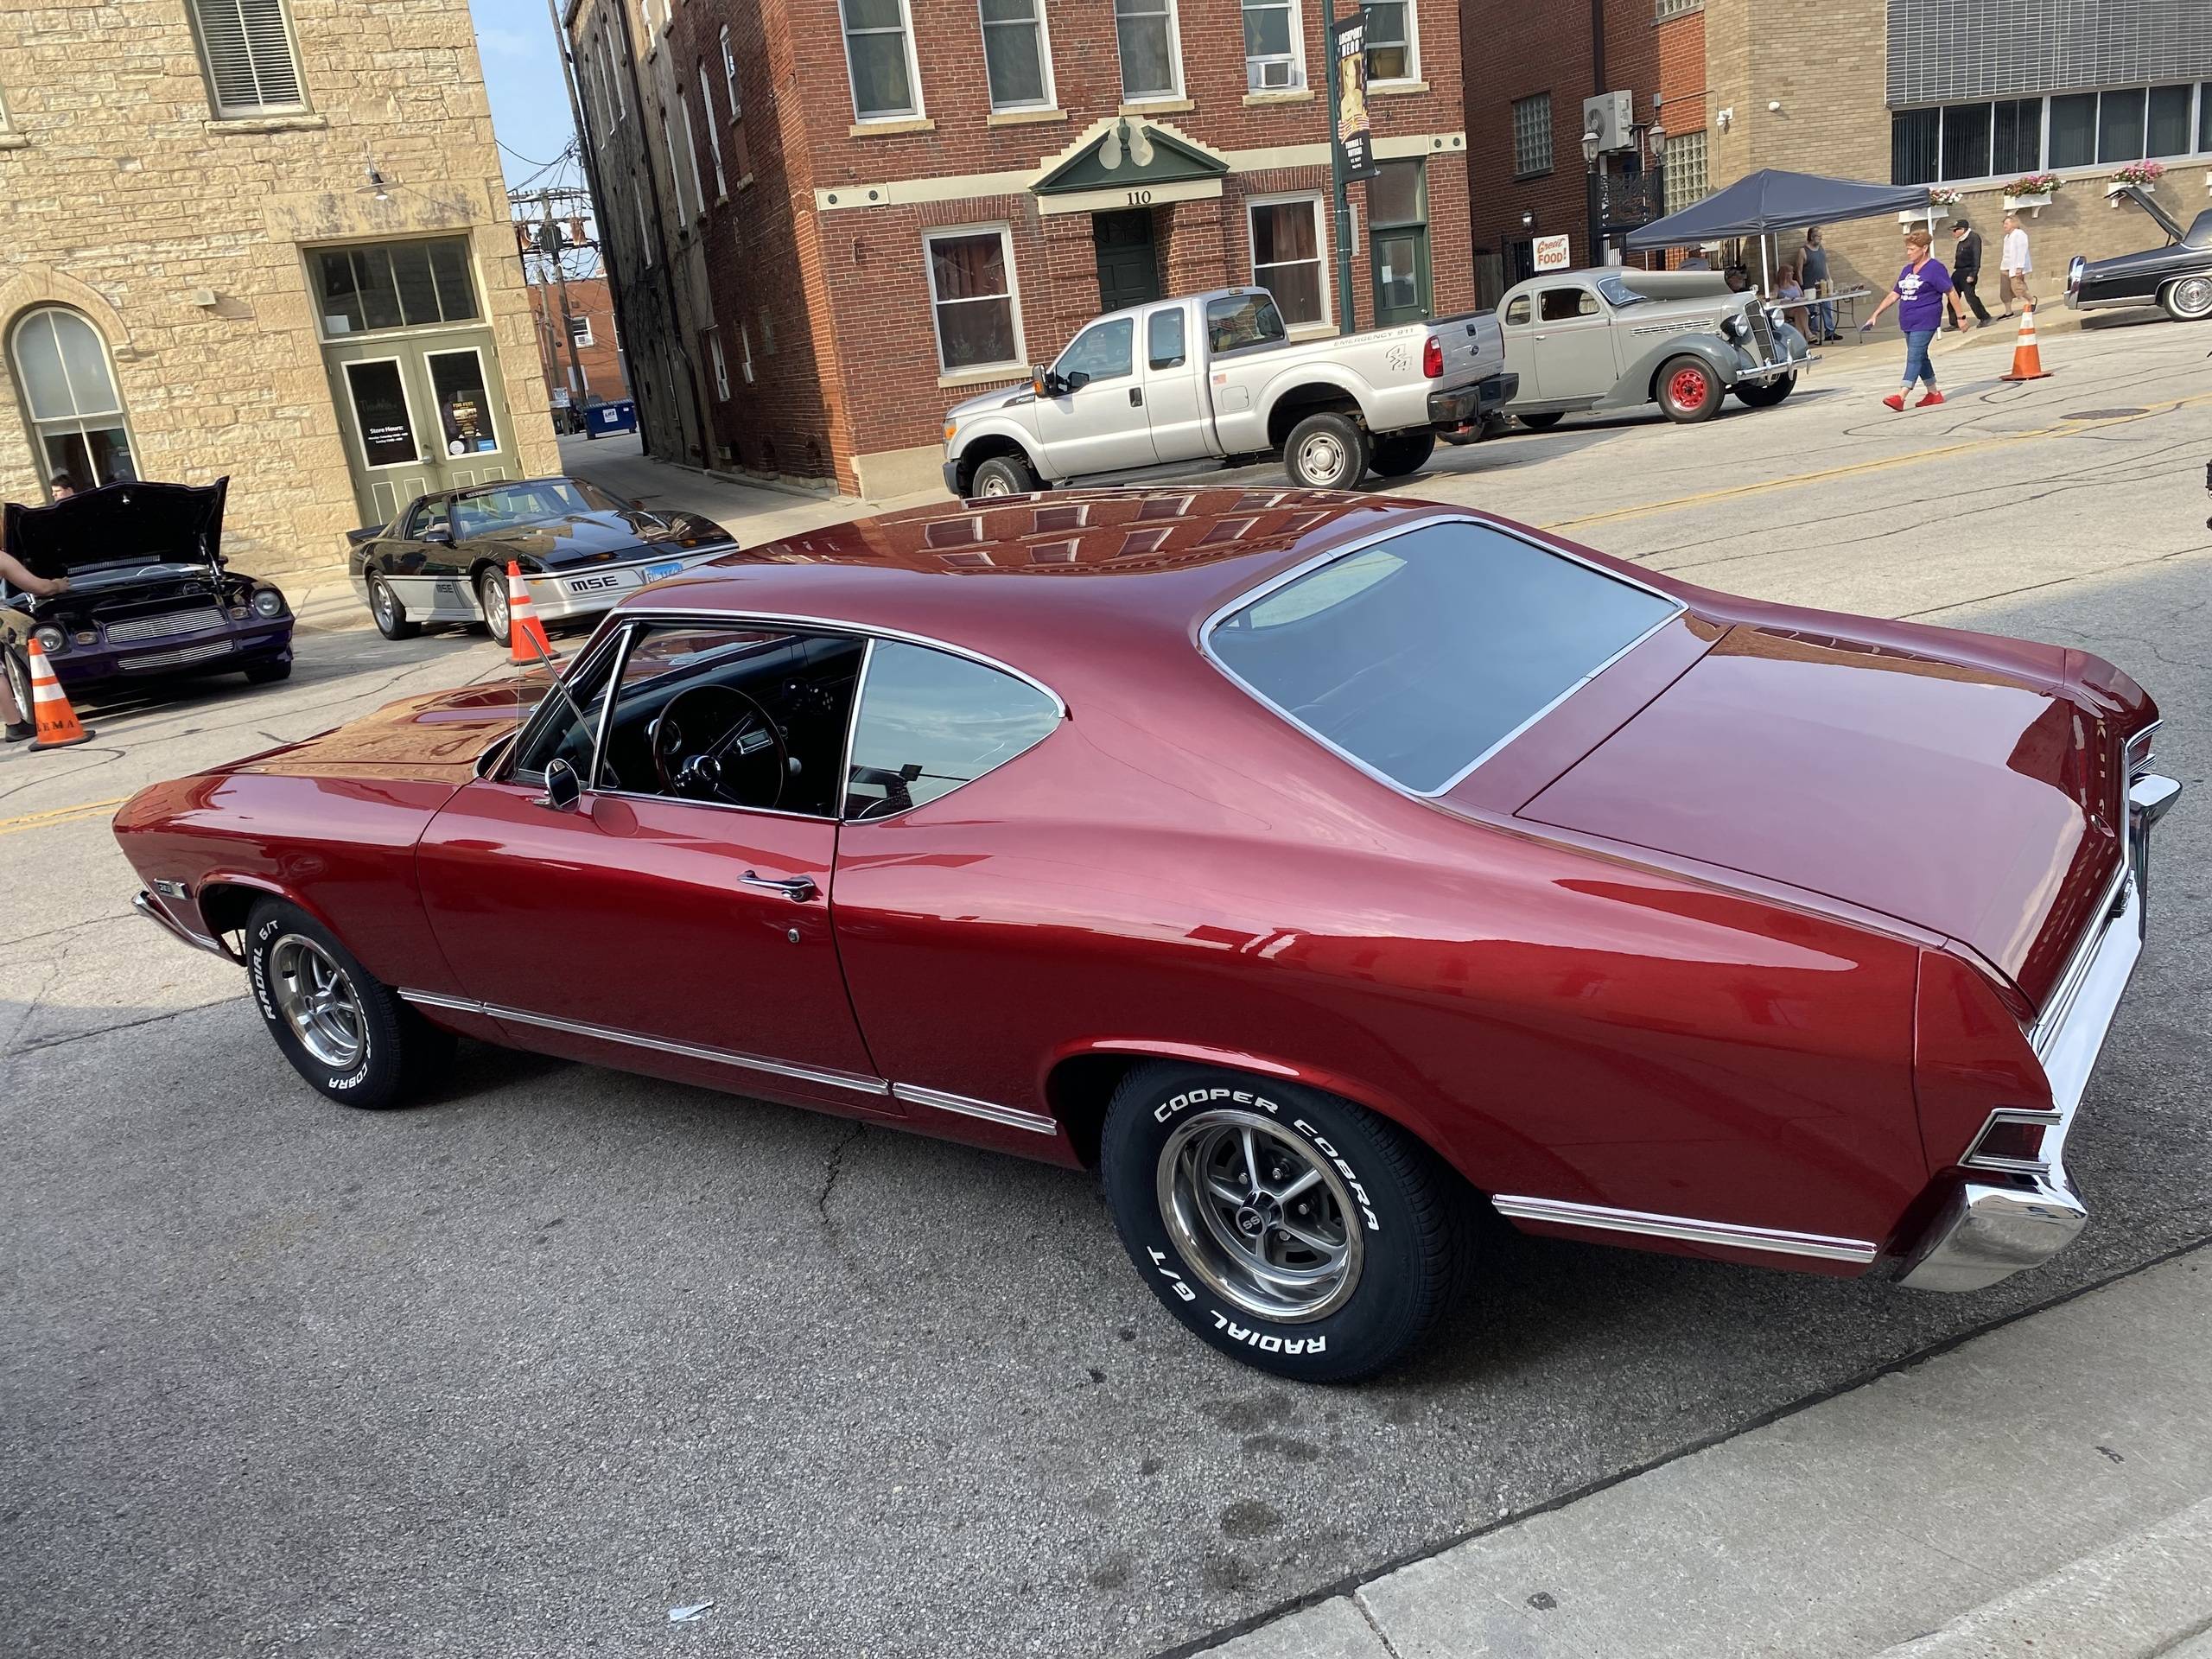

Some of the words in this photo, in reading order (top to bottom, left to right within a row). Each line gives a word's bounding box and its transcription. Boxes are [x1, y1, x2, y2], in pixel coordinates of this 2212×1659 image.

[1338, 25, 1363, 46] LOCKPORT
[1342, 39, 1360, 58] HERO
[1127, 190, 1152, 206] 110
[1537, 238, 1566, 254] Great
[1537, 247, 1567, 265] FOOD!
[1333, 332, 1393, 347] EMERGENCY
[1397, 327, 1414, 336] 911
[435, 584, 454, 594] MSE
[570, 575, 619, 592] MSE
[258, 919, 279, 941] G/T
[253, 947, 276, 1020] RADIAL
[327, 1061, 368, 1090] COBRA
[1154, 1088, 1279, 1123] COOPER
[1293, 1119, 1380, 1231] COBRA
[1242, 1215, 1261, 1230] SS
[1146, 1245, 1197, 1302] G/T
[1210, 1309, 1327, 1355] RADIAL
